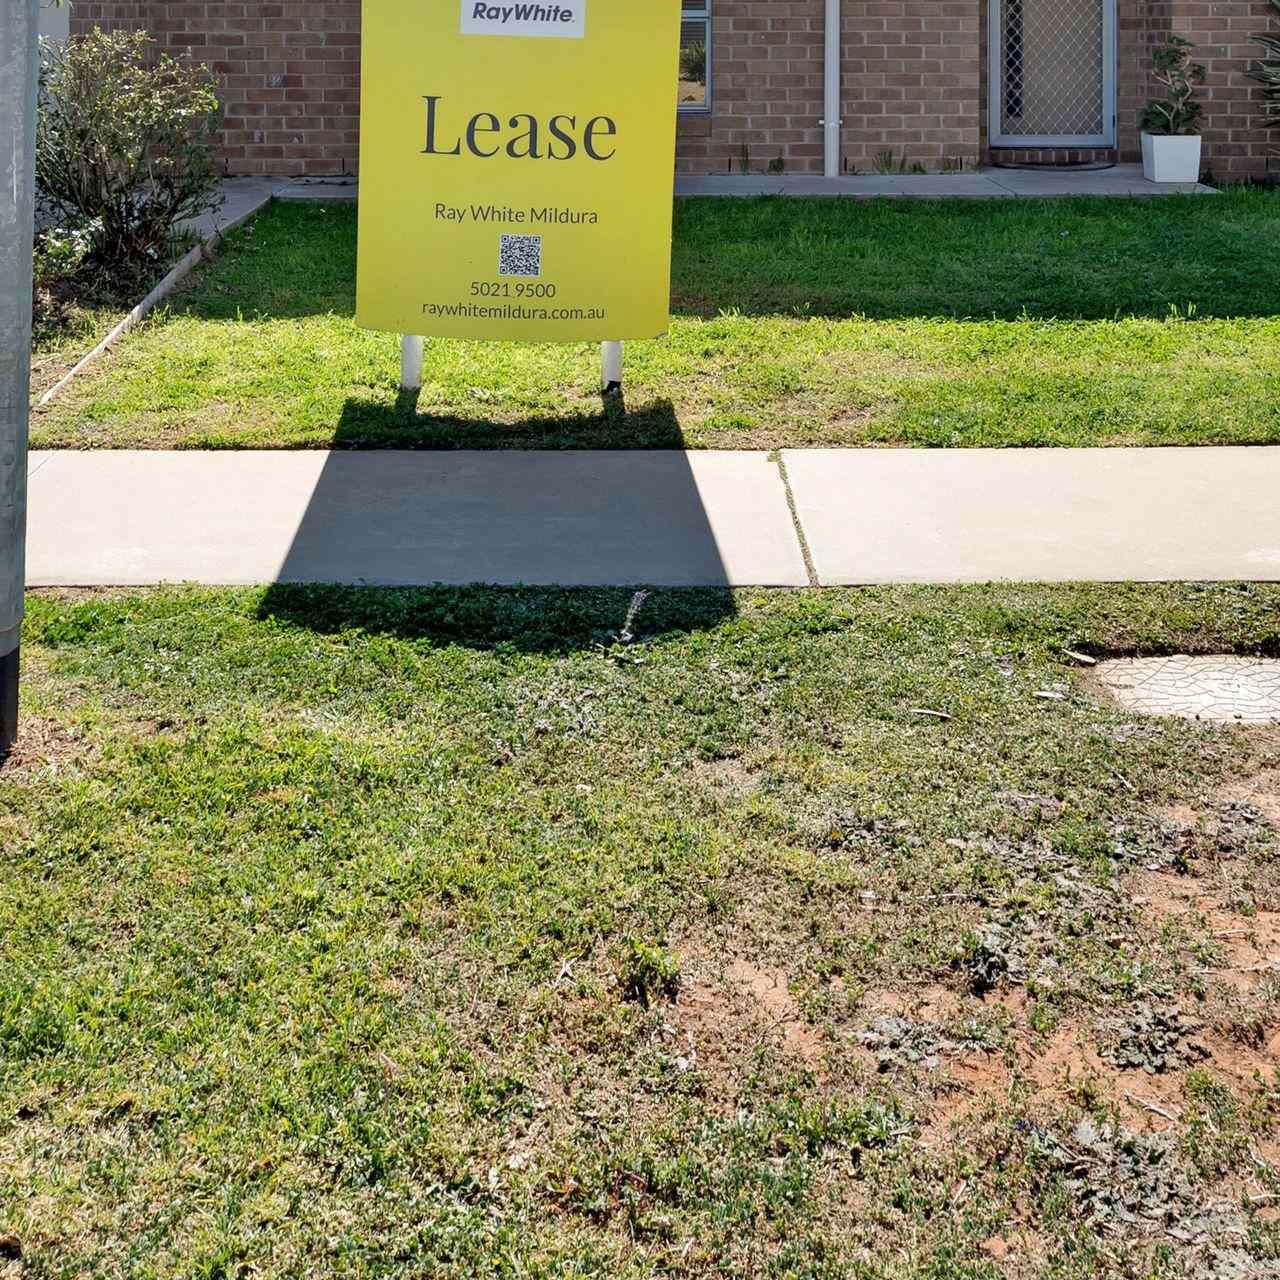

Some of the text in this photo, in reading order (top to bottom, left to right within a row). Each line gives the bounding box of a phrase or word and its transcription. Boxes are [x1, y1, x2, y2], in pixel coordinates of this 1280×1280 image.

[420, 95, 617, 161] Lease
[435, 203, 598, 224] Ray White Mildura
[471, 282, 556, 298] 5021 9500
[422, 302, 605, 320] raywhitemildura.com.au
